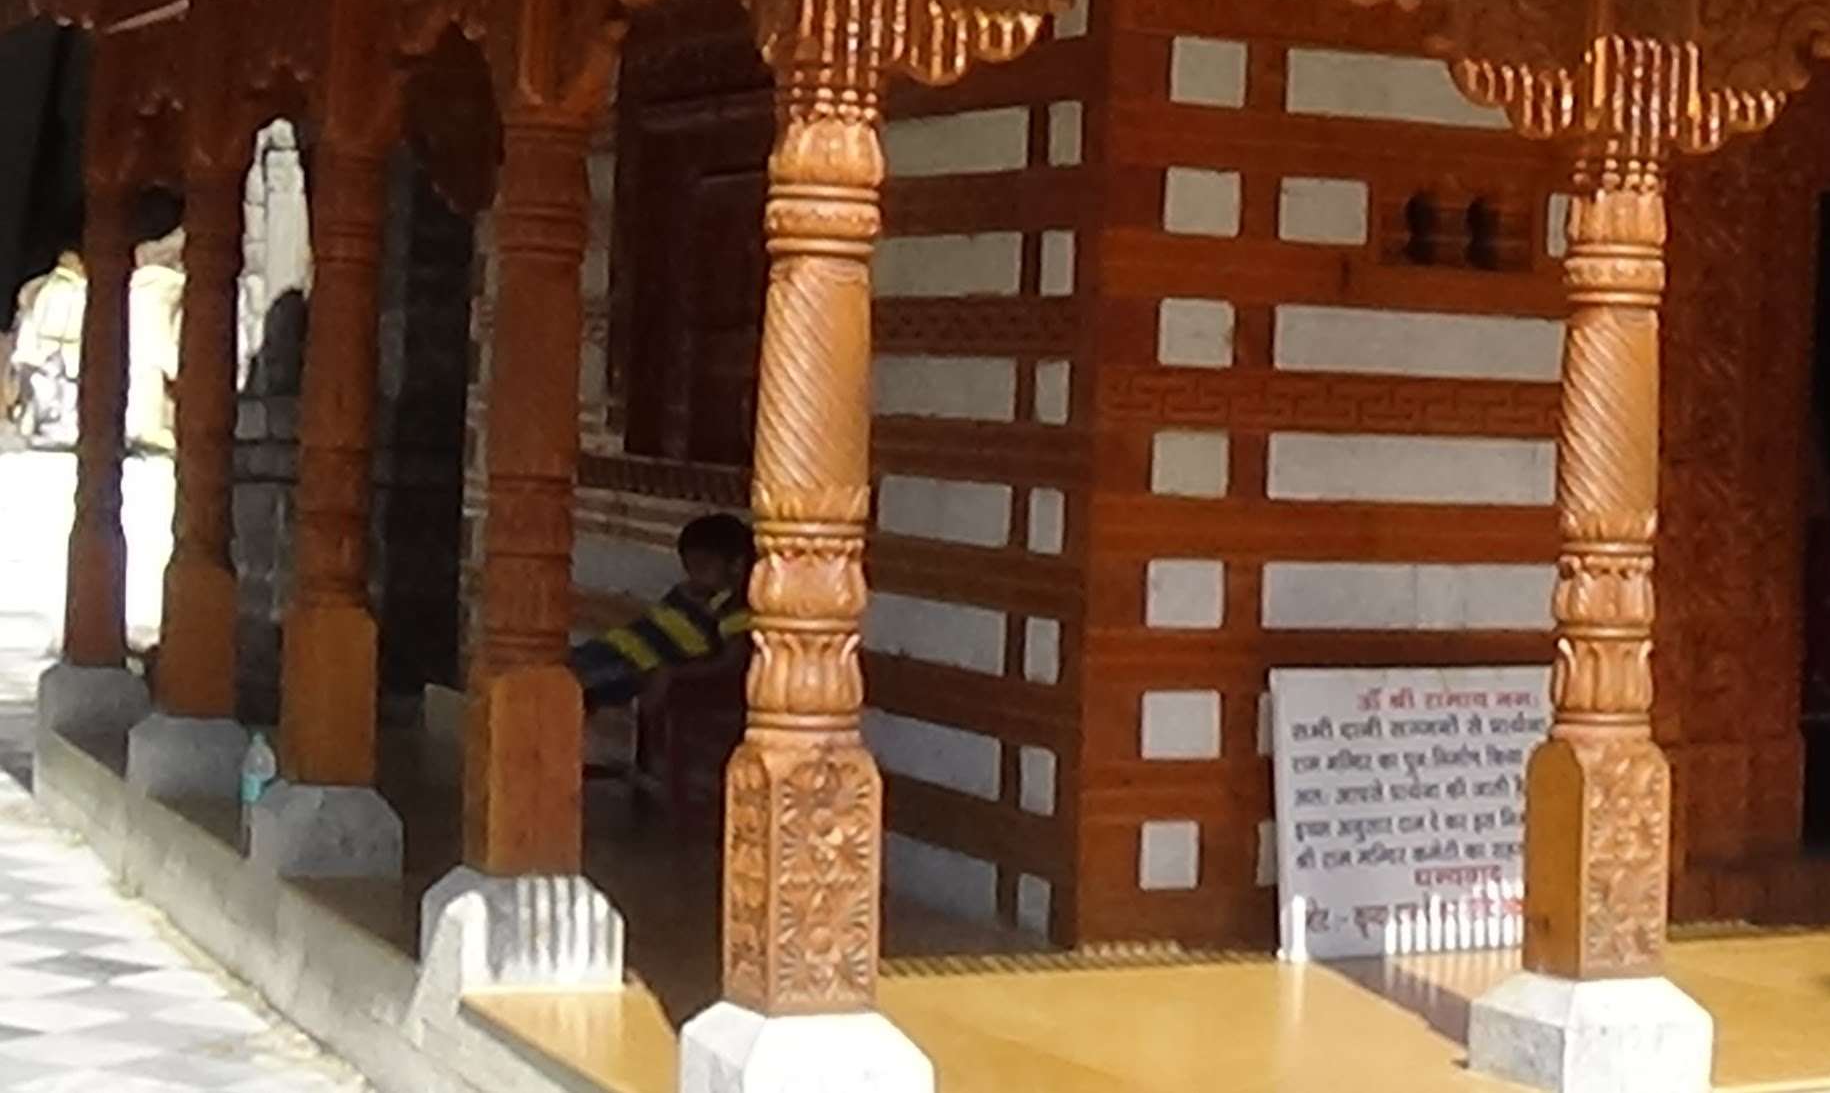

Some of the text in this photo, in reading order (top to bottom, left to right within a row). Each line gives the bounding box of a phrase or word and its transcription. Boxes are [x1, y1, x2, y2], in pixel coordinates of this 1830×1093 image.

[1389, 687, 1414, 708] श्री
[1468, 713, 1482, 734] से
[1415, 864, 1501, 885] धन्यवाद
